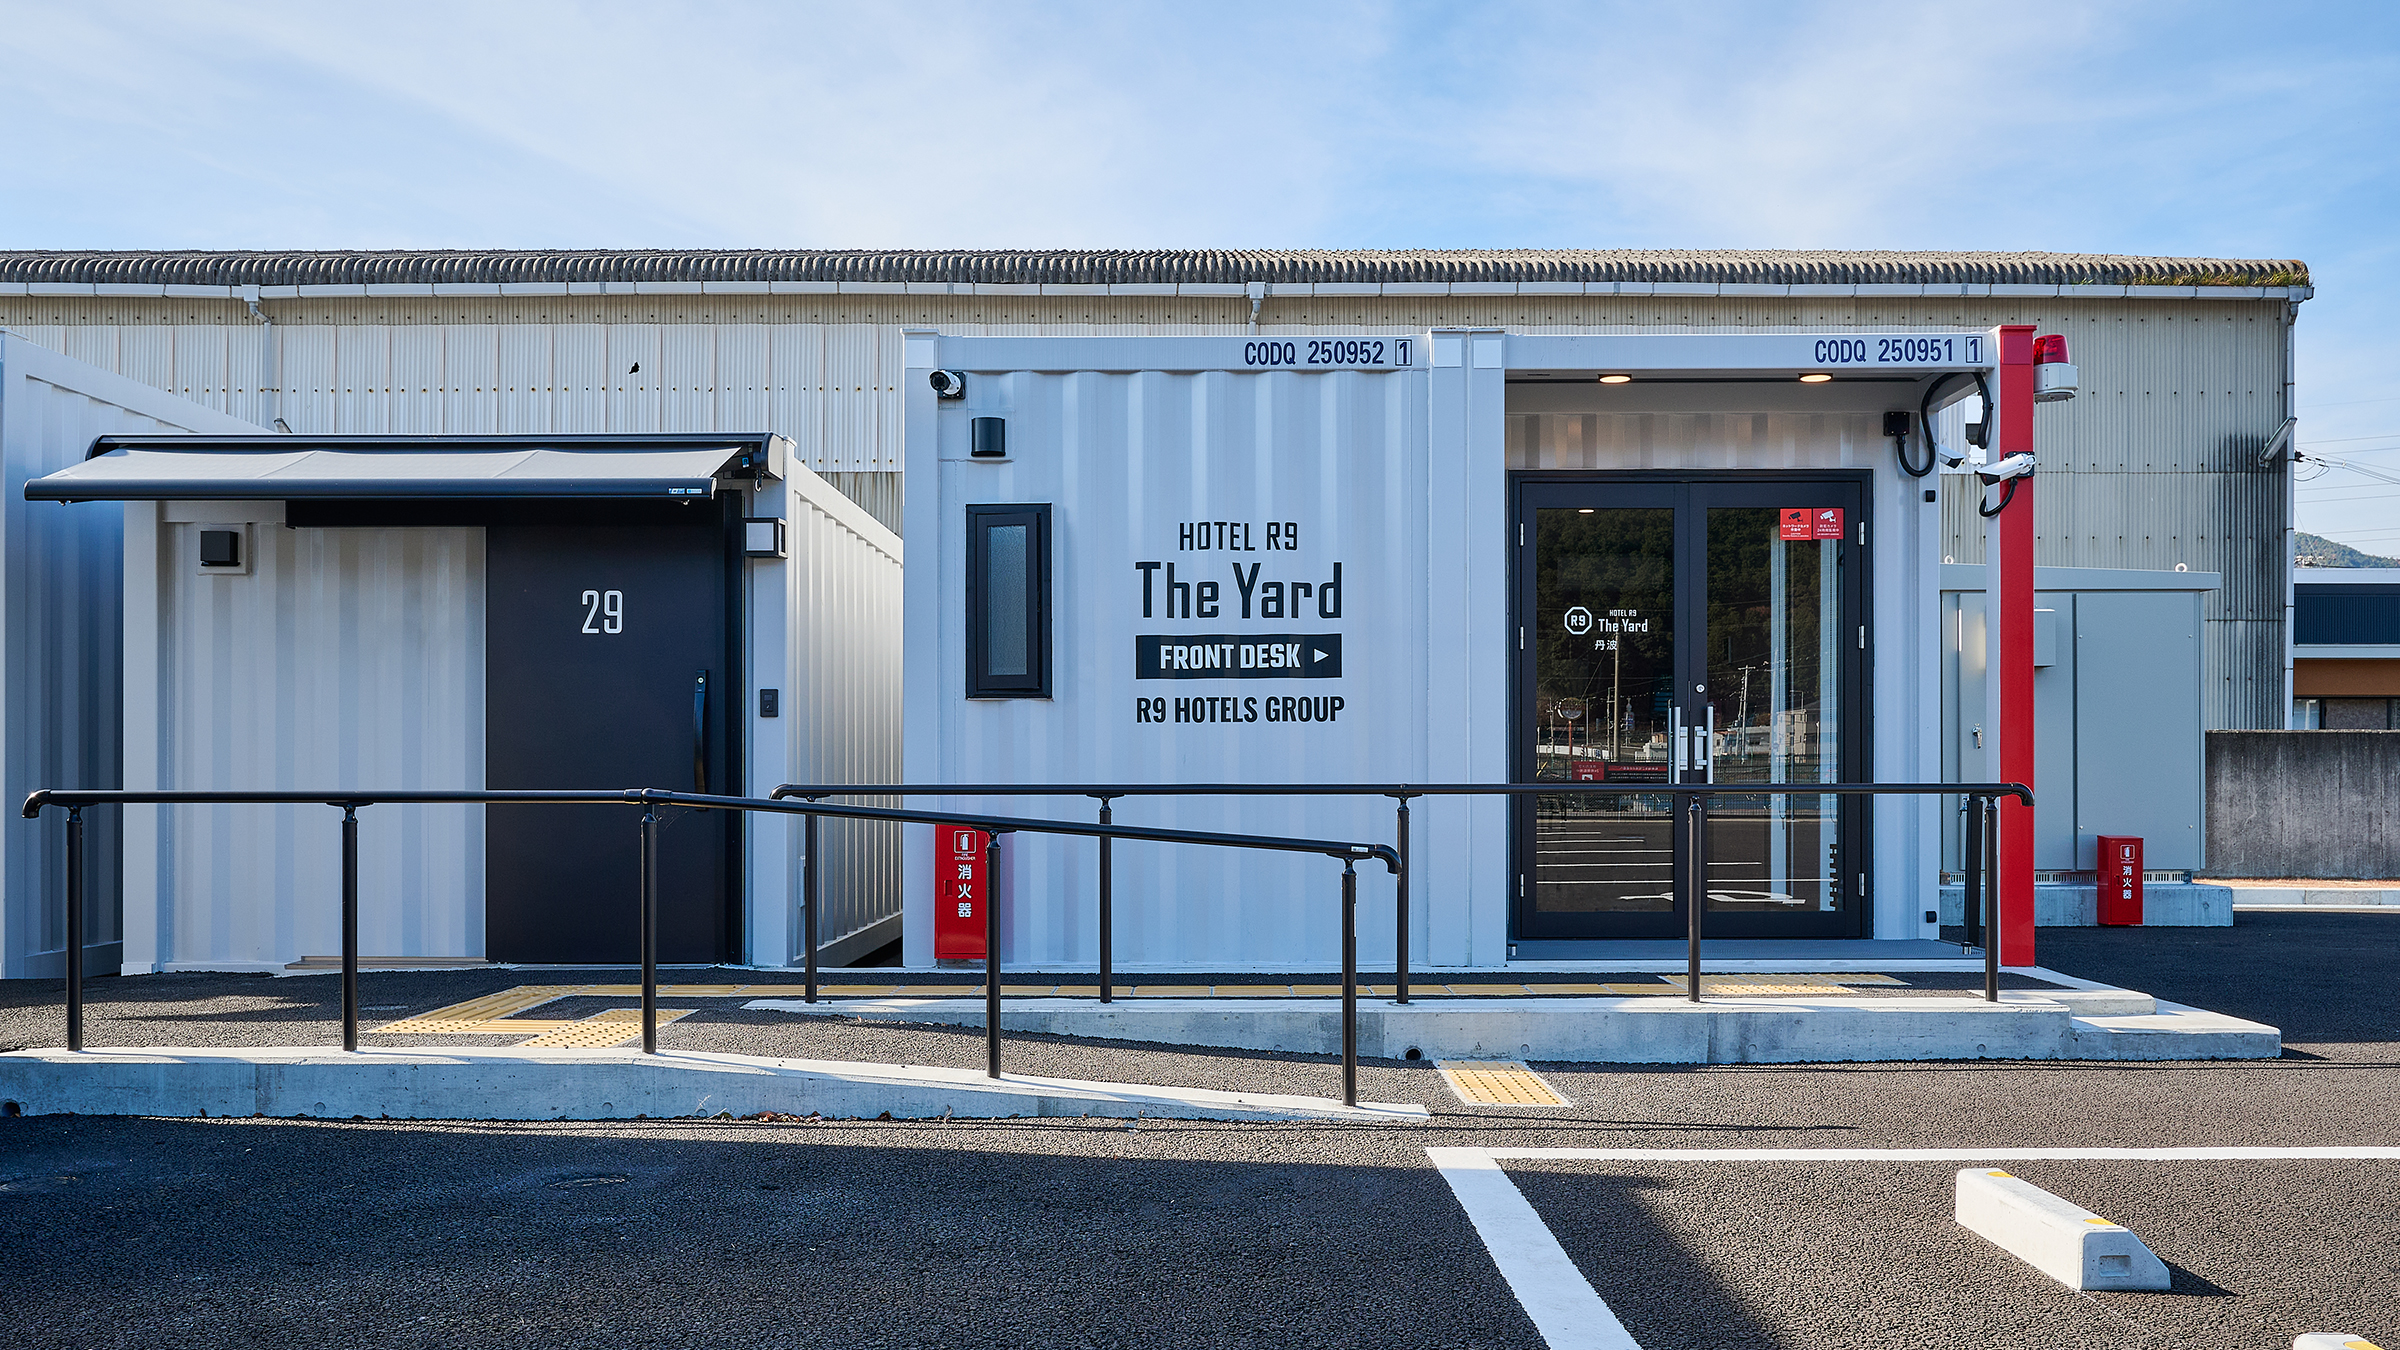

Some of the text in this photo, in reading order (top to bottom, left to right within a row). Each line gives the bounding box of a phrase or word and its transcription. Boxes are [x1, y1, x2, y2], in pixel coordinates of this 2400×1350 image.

[1244, 341, 1296, 366] CODQ
[1307, 341, 1384, 365] 250952
[1815, 339, 1866, 363] CODQ
[1878, 338, 1953, 362] 250951
[1179, 521, 1298, 551] HOTEL R9
[1135, 561, 1343, 619] The Yard
[581, 589, 623, 634] 29
[1570, 615, 1586, 627] R9
[1598, 618, 1648, 632] The Yard
[1609, 609, 1637, 617] HOTEL R9
[1160, 643, 1301, 670] FRONT DESK
[1594, 639, 1618, 651] 丹波
[1136, 696, 1345, 723] R9 HOTELS GROUP
[958, 864, 972, 918] 消火器
[2123, 865, 2132, 899] 消火器
